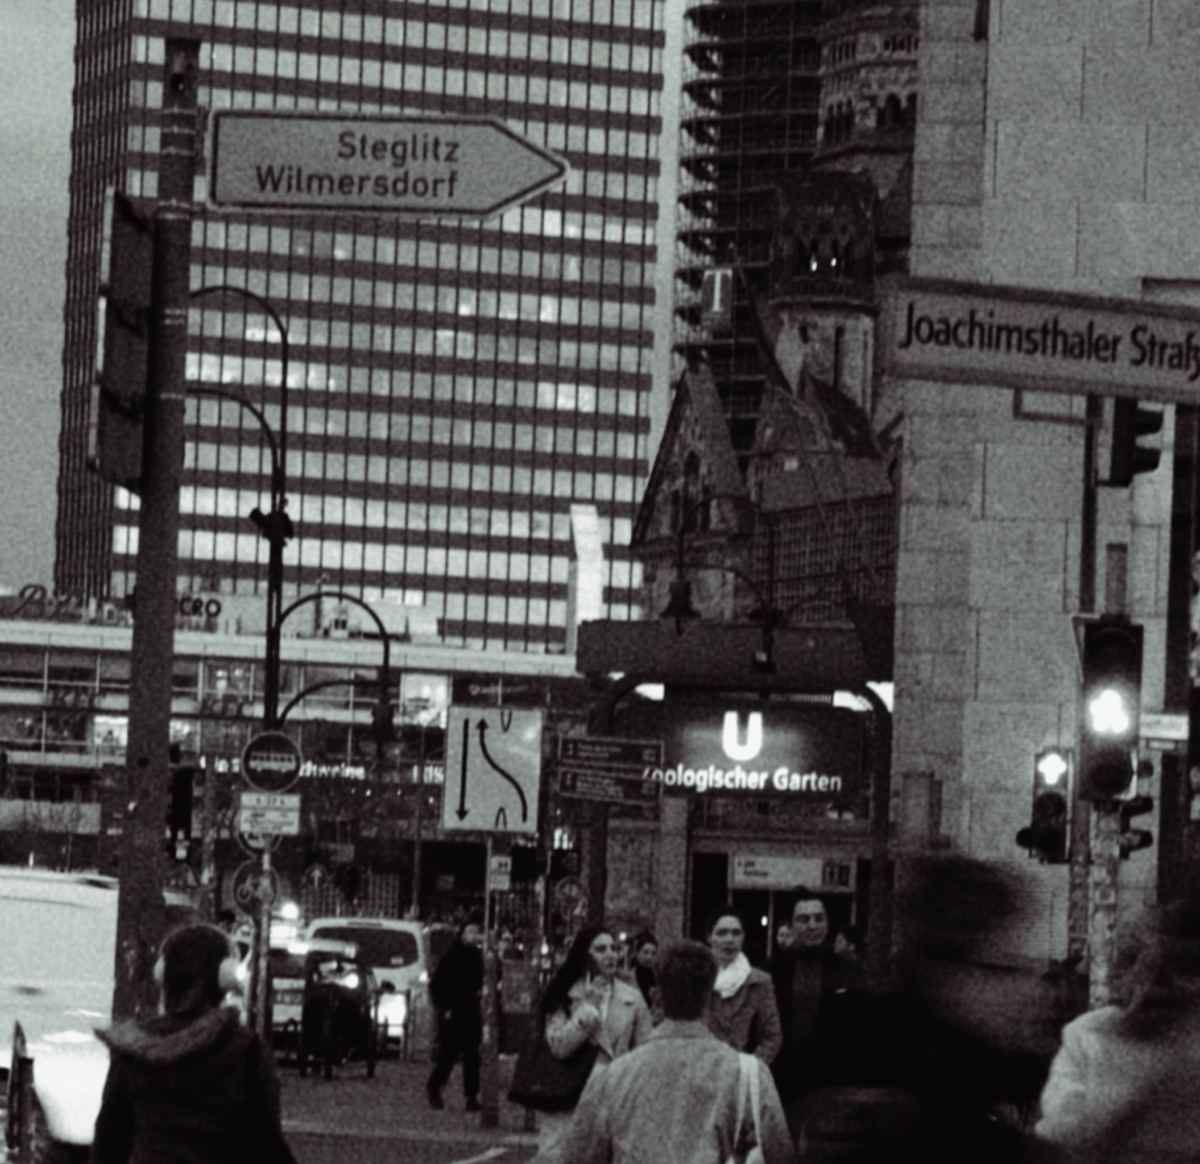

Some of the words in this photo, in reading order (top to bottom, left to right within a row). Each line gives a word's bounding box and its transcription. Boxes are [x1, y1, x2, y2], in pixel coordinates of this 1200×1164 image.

[338, 131, 460, 168] Steglitz
[256, 165, 458, 199] Wilmersdorf
[702, 269, 733, 312] T
[899, 301, 1122, 365] Joachimsthaler
[721, 710, 764, 762] U
[772, 766, 843, 792] Garten
